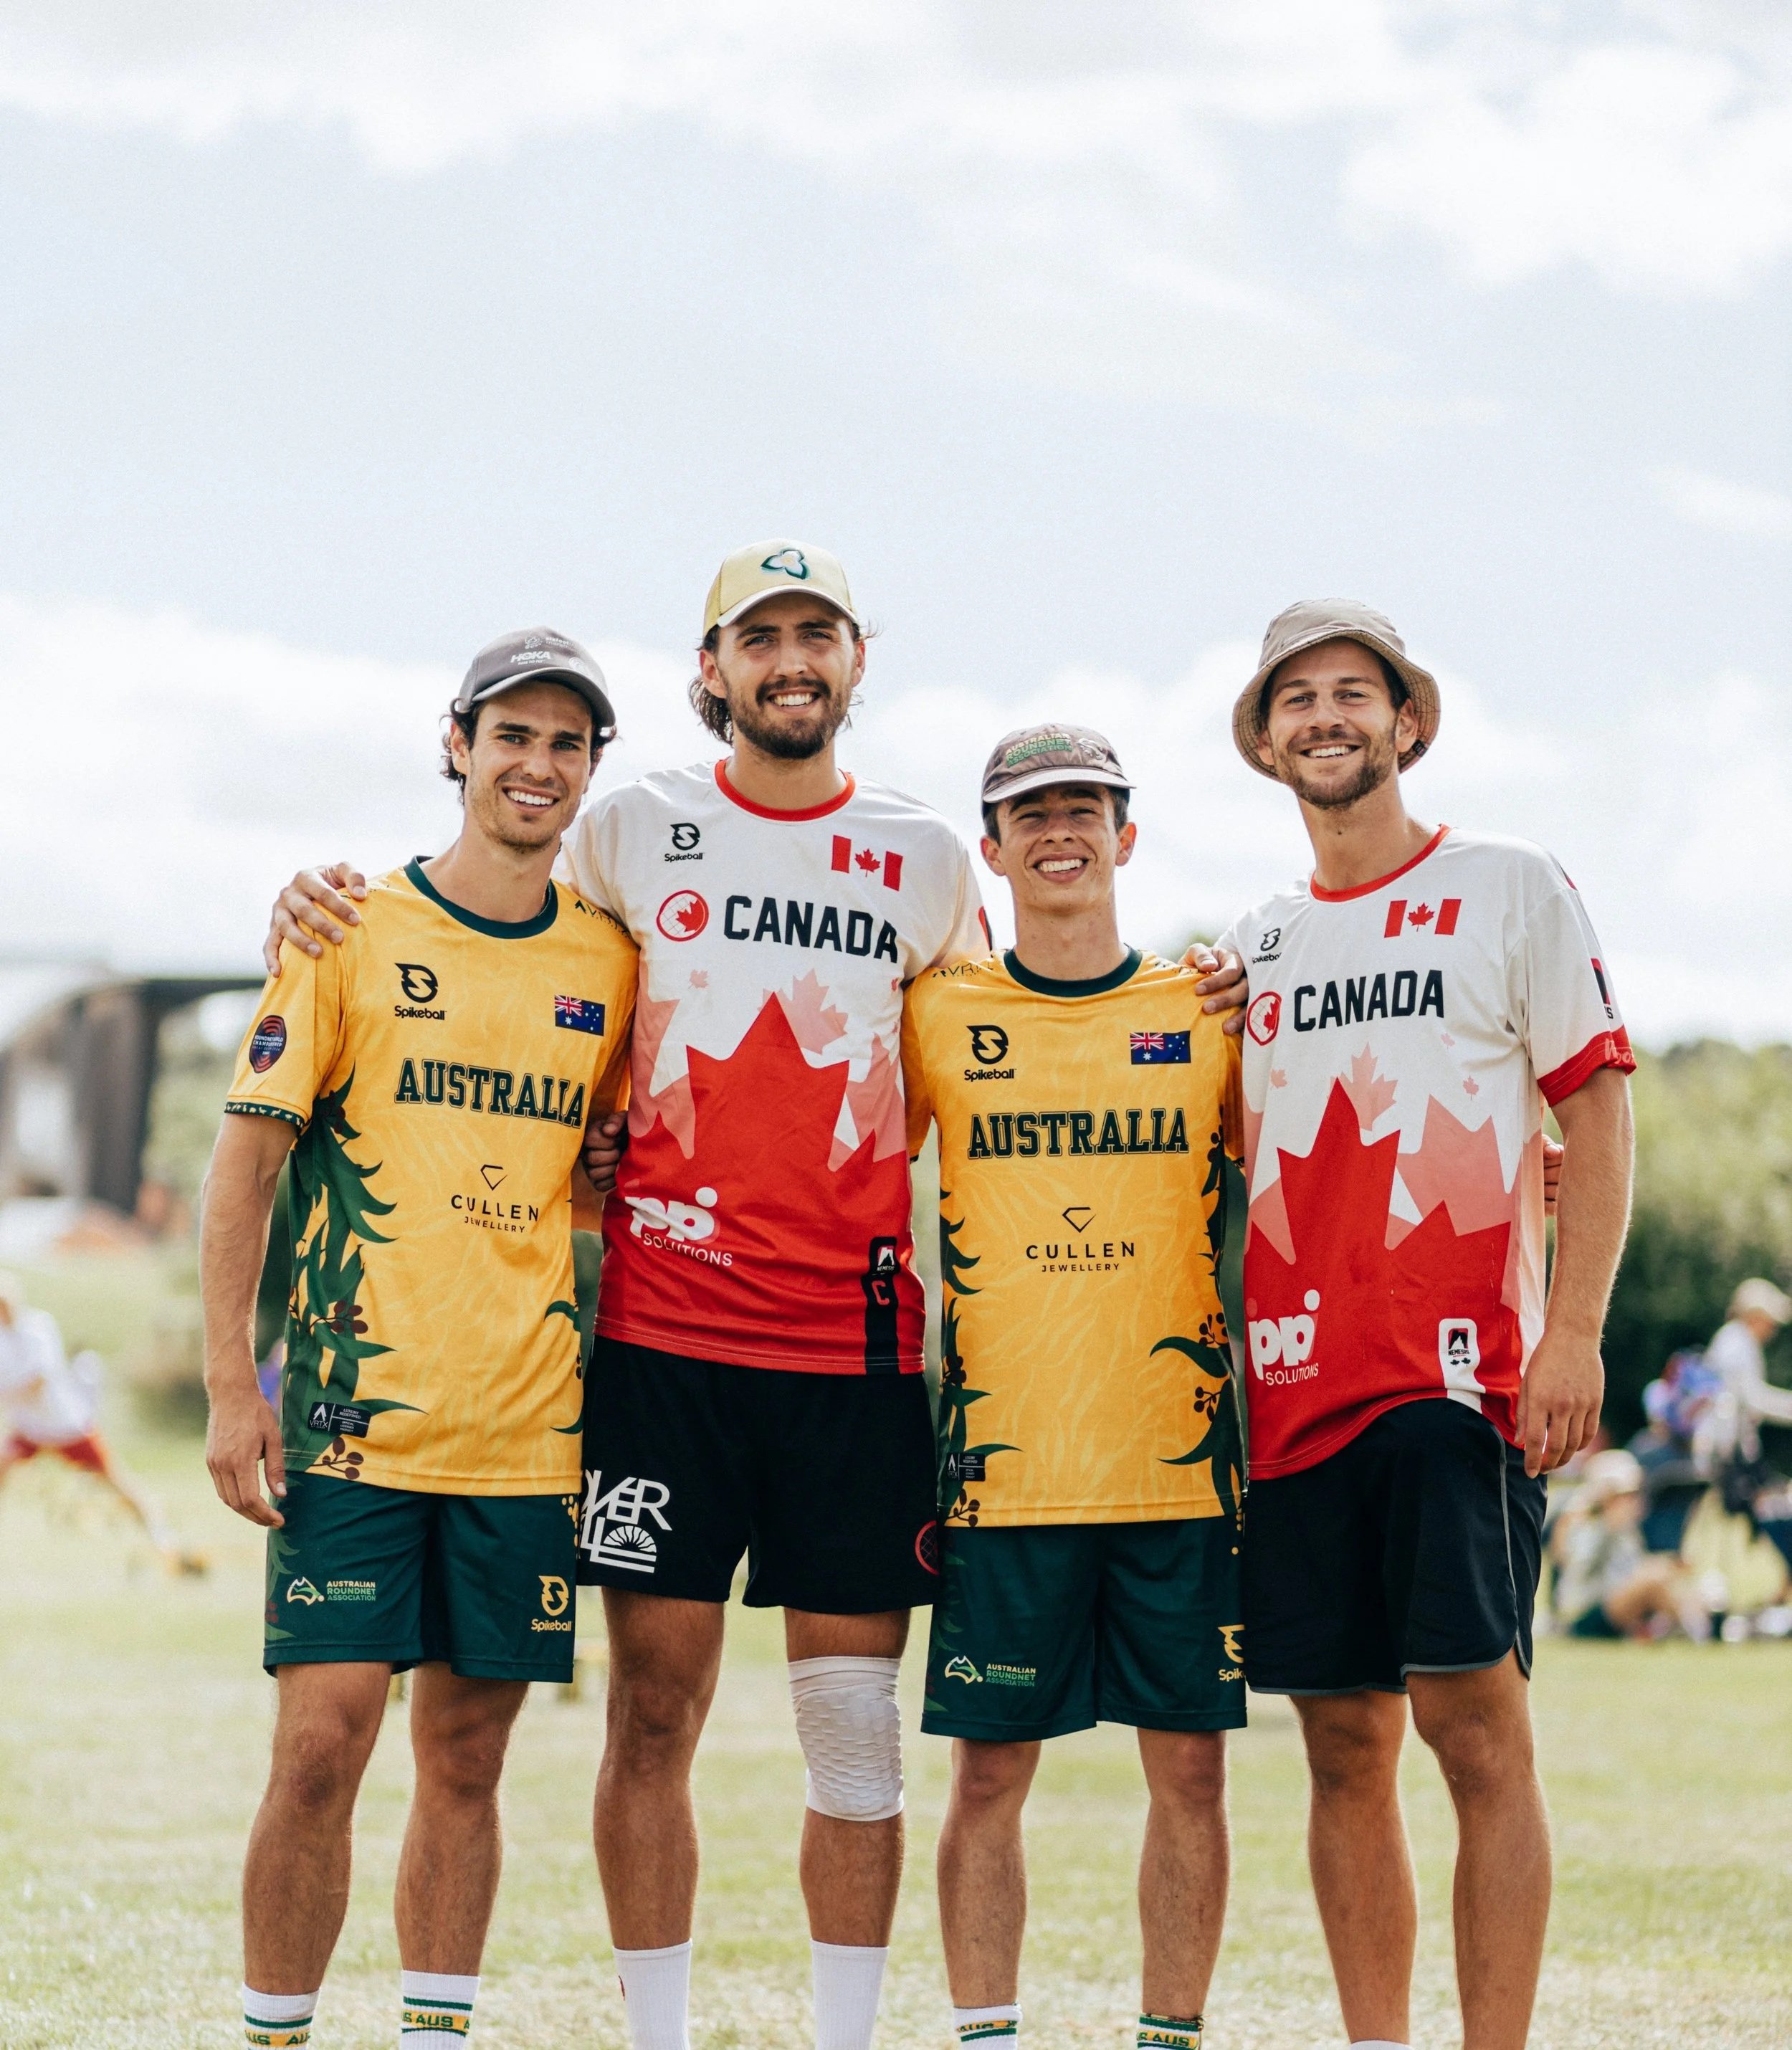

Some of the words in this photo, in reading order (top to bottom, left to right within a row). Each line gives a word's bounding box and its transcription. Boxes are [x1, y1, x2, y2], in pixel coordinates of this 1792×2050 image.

[510, 651, 551, 663] HOKA
[1005, 733, 1071, 755] AUSTRALIAN
[1006, 739, 1072, 761] ROUNDNET
[1006, 745, 1073, 768] ASSOCIATION
[664, 852, 703, 862] Spikeball
[724, 895, 899, 963] CANADA
[1294, 970, 1444, 1031] CANADA
[394, 1006, 446, 1021] Spikeball
[964, 1069, 1015, 1082] Spikeball
[394, 1058, 585, 1129] AUSTRALIA
[968, 1108, 1189, 1159] AUSTRALIA
[451, 1194, 539, 1222] CULLEN
[464, 1216, 525, 1233] JEWELLERY
[643, 1233, 733, 1267] SOLUTIONS
[1026, 1241, 1135, 1259] CULLEN
[1042, 1263, 1120, 1272] JEWELLERY
[1265, 1363, 1319, 1386] SOLUTIONS
[310, 1419, 328, 1428] VRTX
[531, 1618, 571, 1632] Spikeball
[986, 1664, 1036, 1674] AUSTRALIAN
[986, 1670, 1036, 1681] ROUNDNET
[986, 1677, 1035, 1687] ASSOCIATION
[416, 2014, 453, 2027] AUS
[1153, 2034, 1190, 2046] AUS
